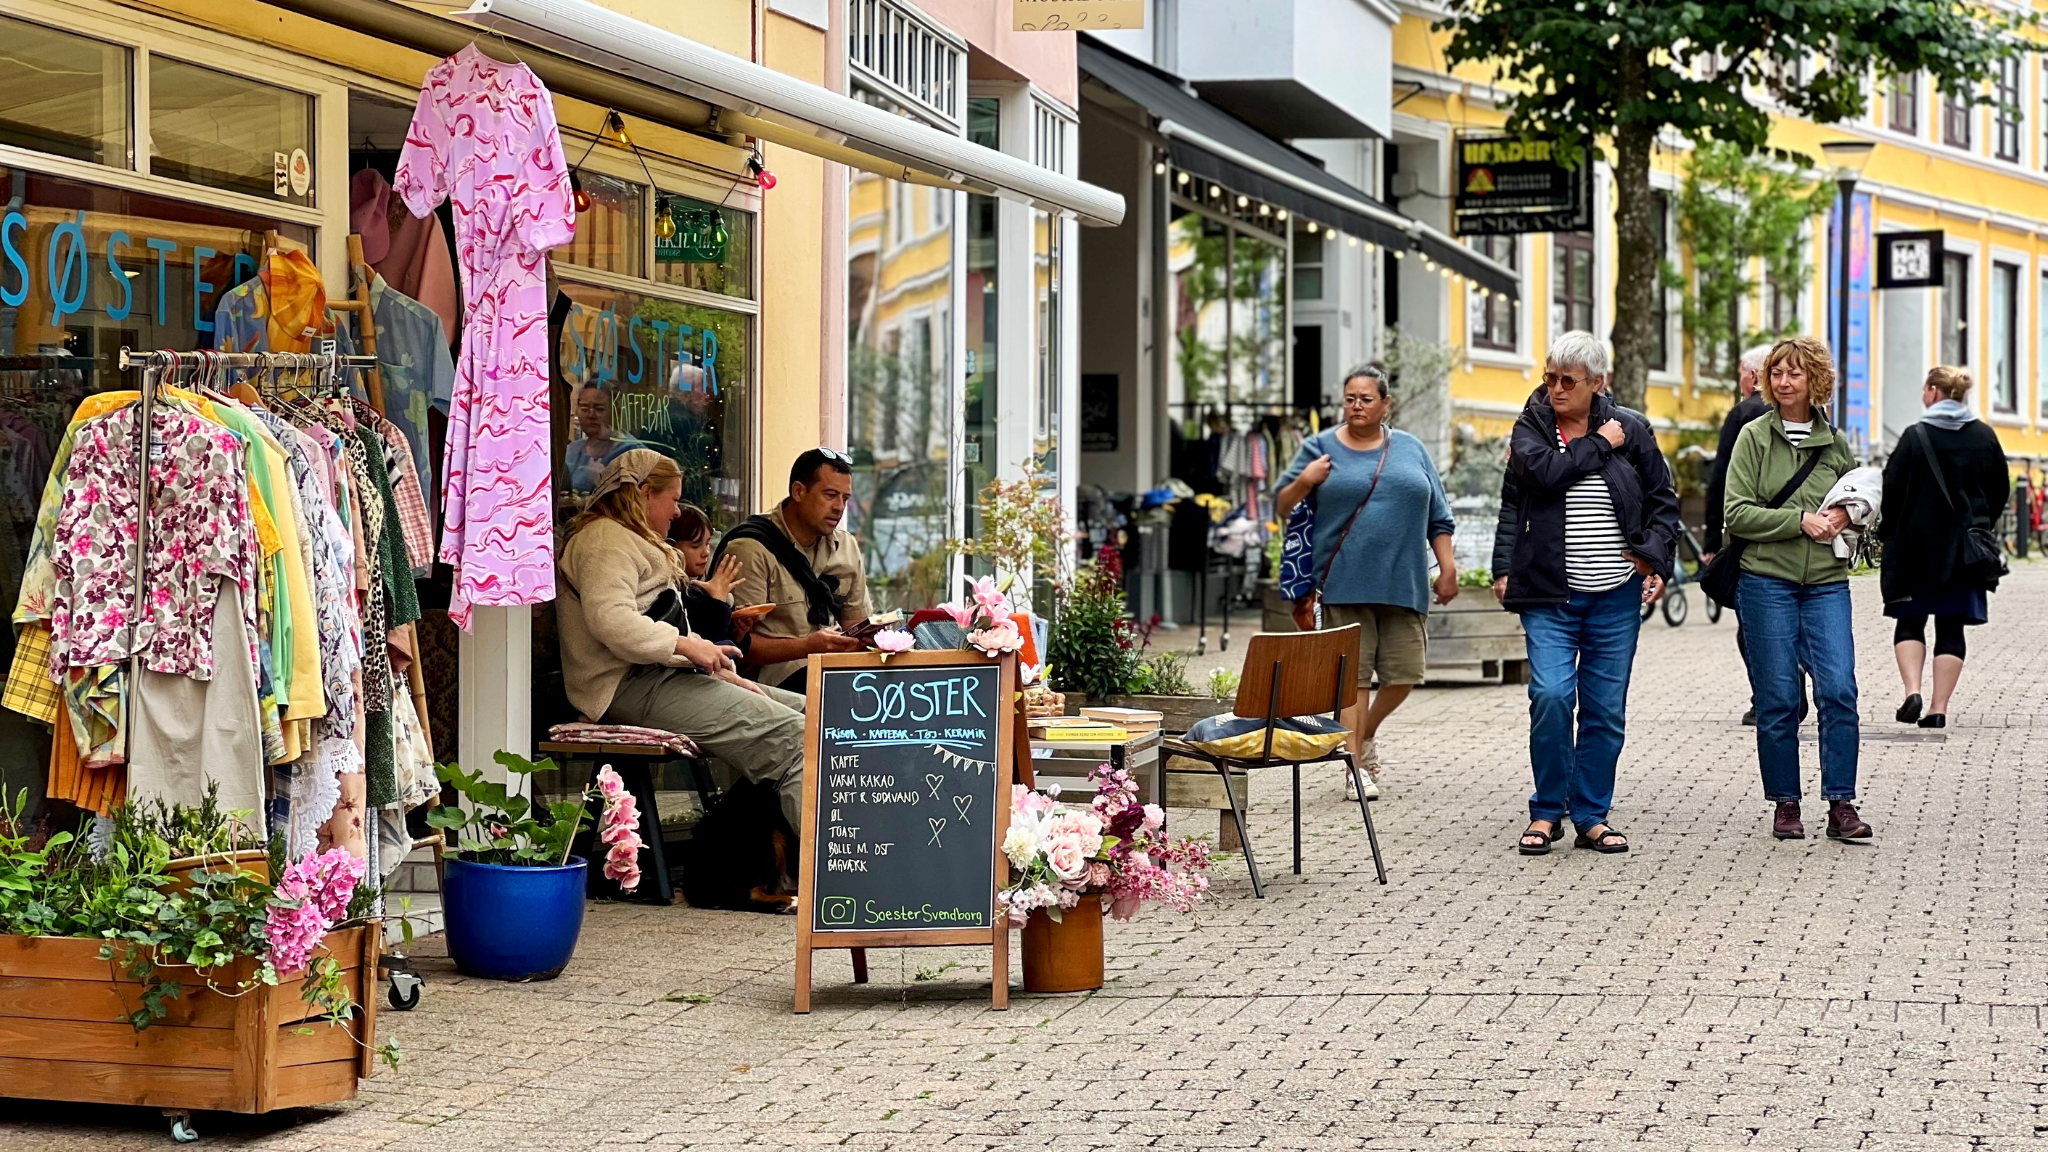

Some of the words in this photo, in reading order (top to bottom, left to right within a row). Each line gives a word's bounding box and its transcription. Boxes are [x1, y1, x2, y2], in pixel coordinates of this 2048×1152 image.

[568, 301, 718, 396] SØSTER
[611, 391, 674, 434] KAFFEBAR
[851, 672, 987, 724] SØSTER
[869, 729, 909, 740] KAFFEBAR
[830, 754, 860, 770] KAFFE
[829, 774, 857, 788] VARM
[860, 774, 895, 788] KAKAO
[832, 791, 857, 804] SAFT
[871, 790, 920, 806] SODAVAND
[830, 808, 843, 822] ØL
[828, 825, 860, 839] TOAST
[828, 841, 852, 858] BOLLE
[874, 843, 895, 855] OST
[827, 858, 868, 873] BAGVÆRK
